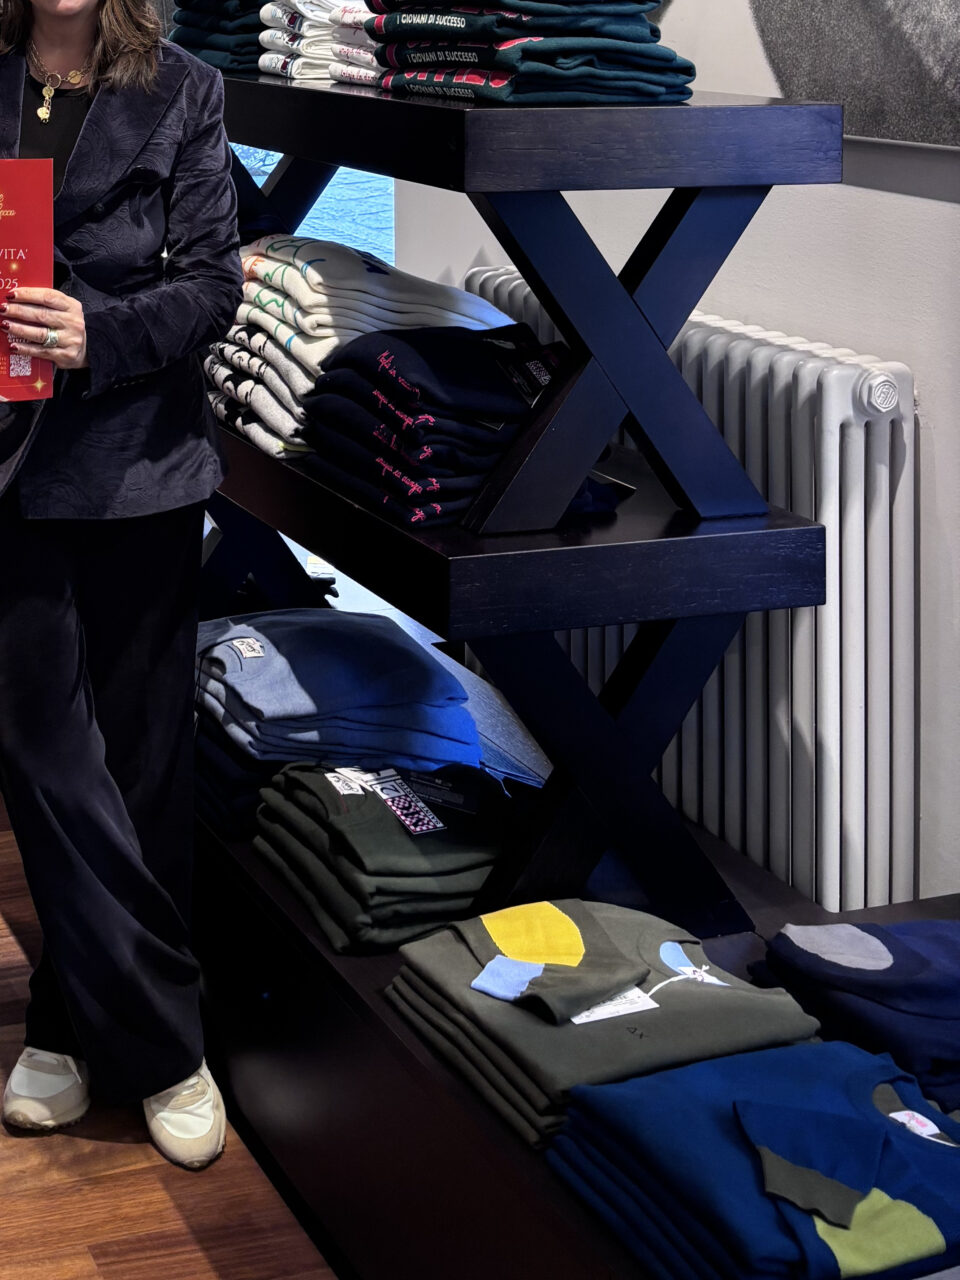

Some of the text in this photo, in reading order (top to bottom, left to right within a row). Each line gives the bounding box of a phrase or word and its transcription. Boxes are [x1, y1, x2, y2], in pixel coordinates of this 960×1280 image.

[401, 14, 428, 25] GIOVANI
[428, 14, 435, 24] DI
[435, 14, 466, 28] SUCCESSO
[411, 52, 438, 63] GIOVANI
[438, 51, 446, 61] DI
[445, 51, 479, 63] SUCCESSO
[411, 84, 434, 94] GIOVANI
[434, 86, 443, 95] DI
[443, 87, 475, 98] SUCCESSO
